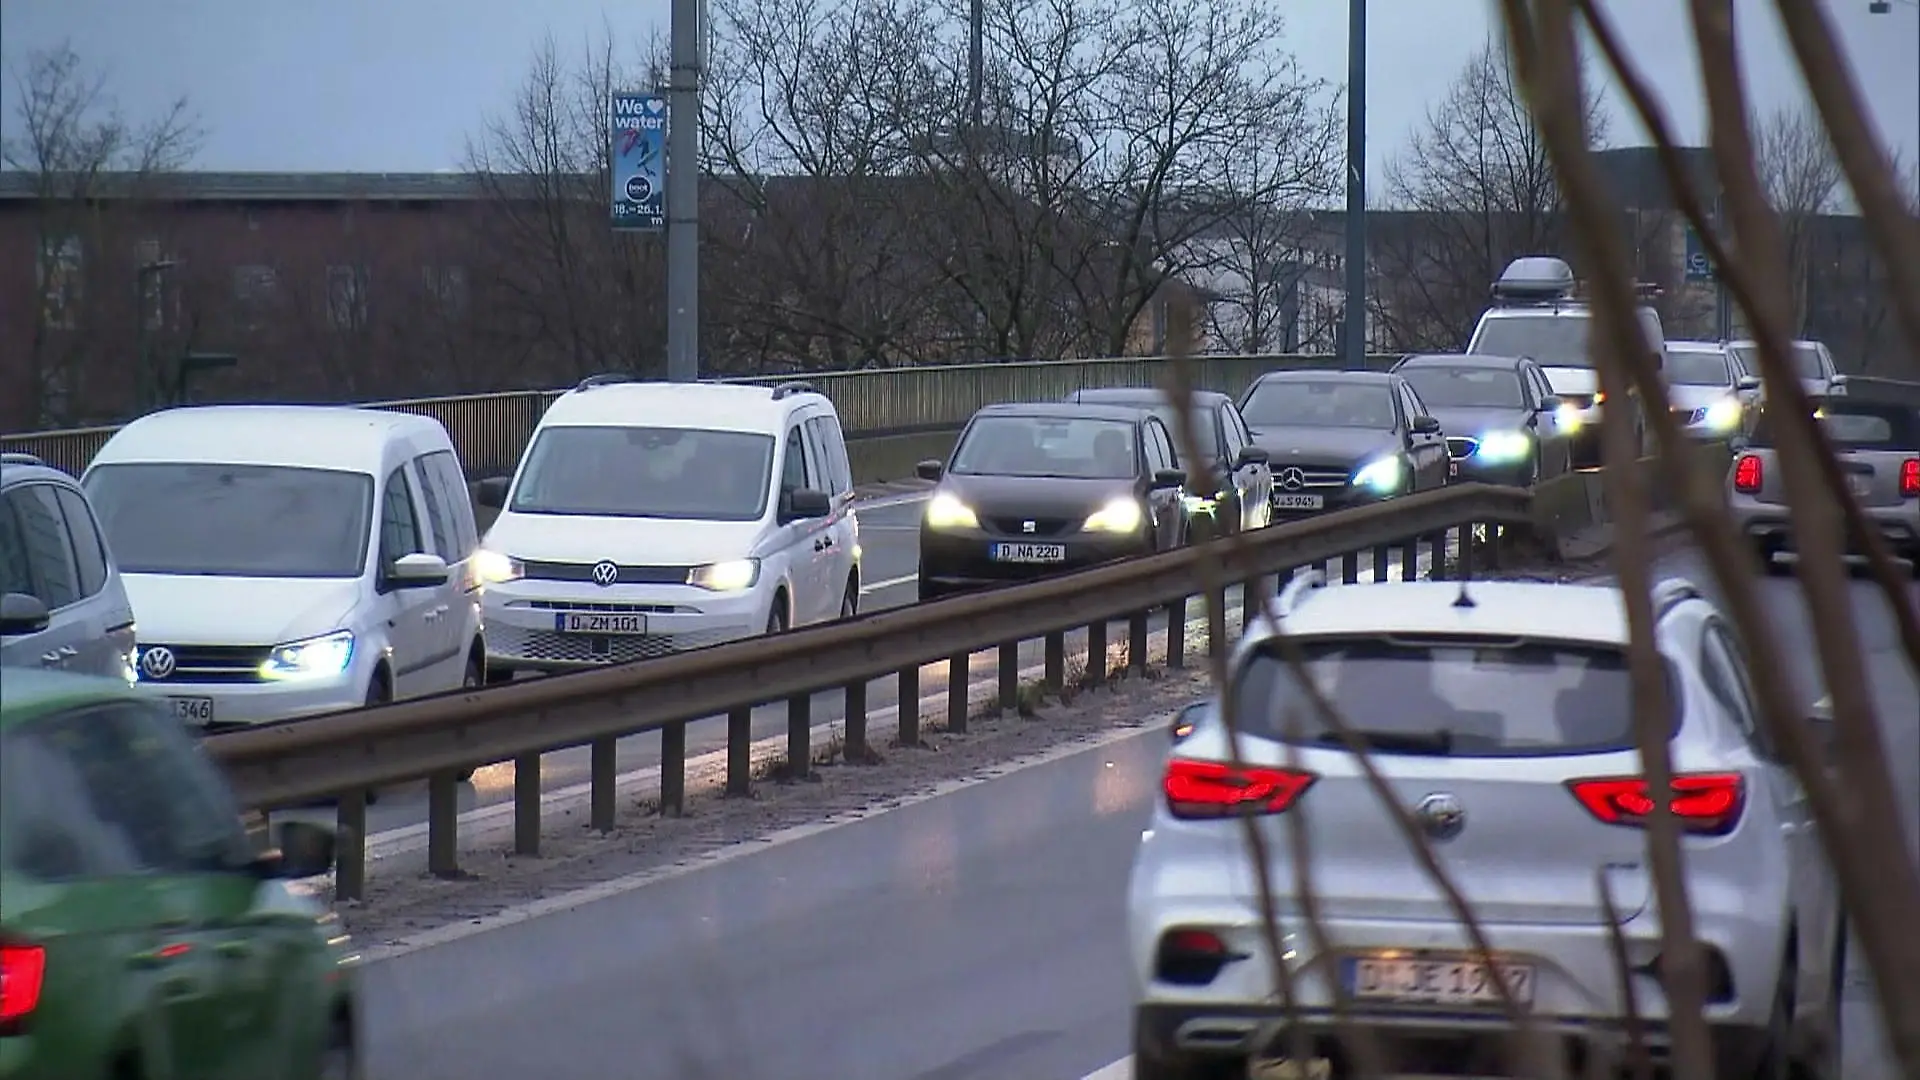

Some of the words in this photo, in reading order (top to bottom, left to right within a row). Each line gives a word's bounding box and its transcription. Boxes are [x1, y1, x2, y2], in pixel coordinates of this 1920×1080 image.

[615, 99, 643, 115] We
[615, 115, 663, 129] water
[1002, 545, 1010, 556] D
[1017, 545, 1033, 558] NA
[1036, 547, 1059, 558] 220
[571, 616, 580, 630] D
[590, 617, 609, 630] ZM
[612, 617, 639, 632] 101
[1448, 966, 1528, 997] 197
